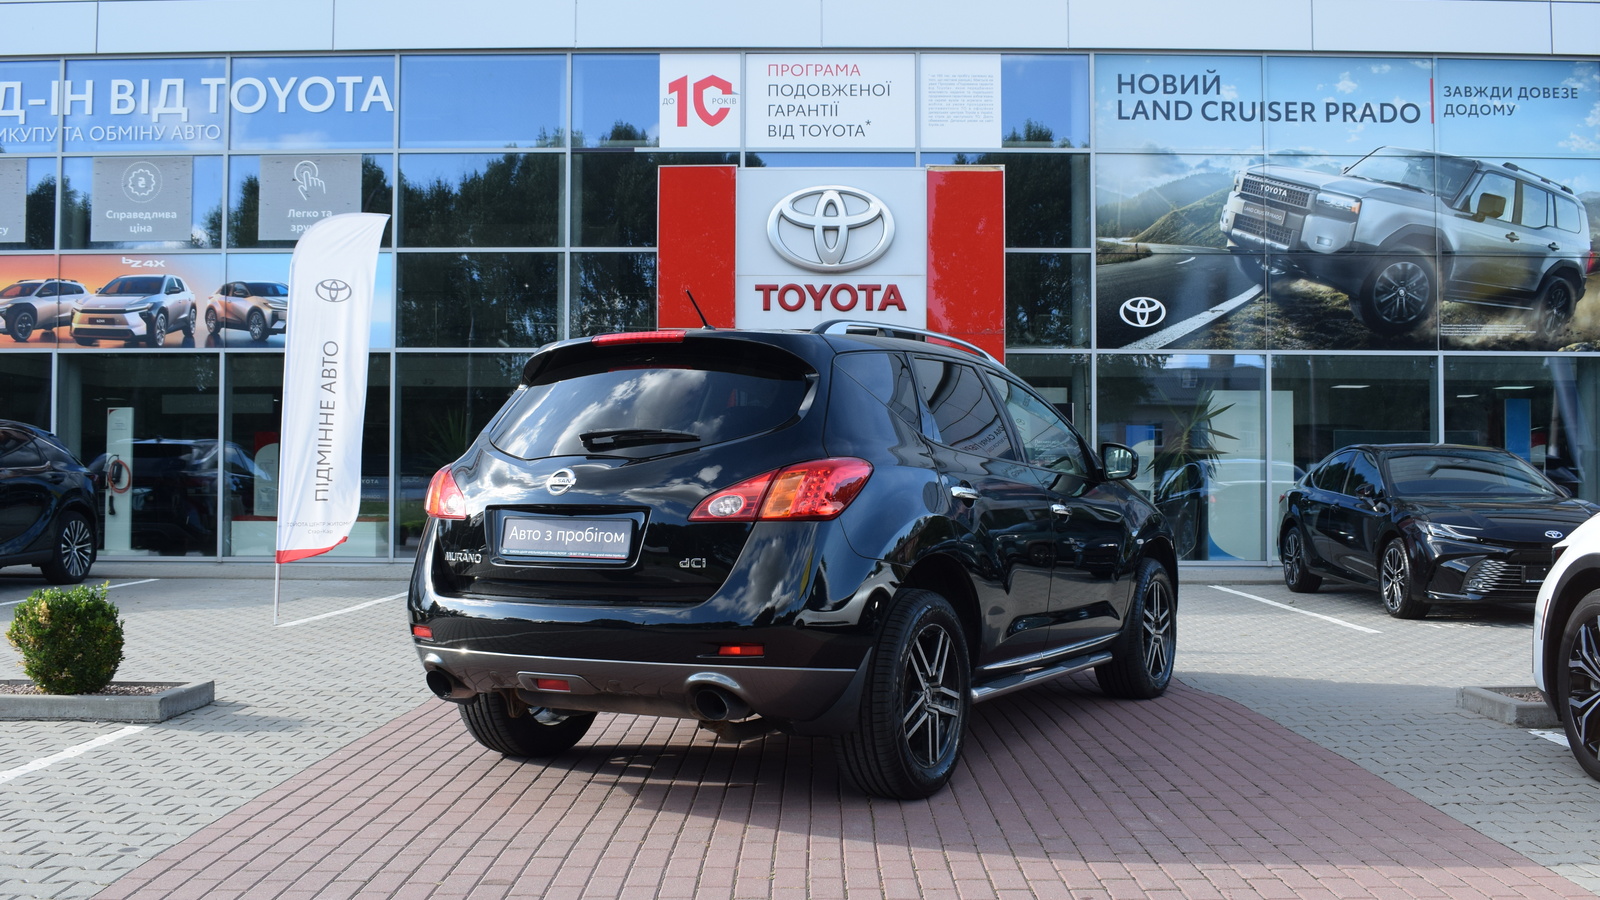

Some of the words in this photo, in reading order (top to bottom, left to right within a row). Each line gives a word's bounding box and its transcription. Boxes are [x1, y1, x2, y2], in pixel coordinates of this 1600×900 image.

[768, 64, 861, 77] ПРОГРАМА
[768, 80, 892, 99] ПОДОВЖЕНОЇ
[1117, 69, 1221, 95] НОВИЙ
[110, 79, 188, 123] ВІД
[201, 76, 394, 114] TOYOTA
[1443, 86, 1513, 100] ЗАВЖДИ
[1517, 87, 1579, 101] ДОВЕЗЕ
[662, 98, 675, 106] ДО
[768, 101, 839, 117] ГАРАНТІЇ
[1117, 100, 1193, 121] LAND
[1201, 101, 1316, 122] CRUISER
[1325, 103, 1421, 124] PRADO
[1443, 104, 1516, 118] ДОДОМУ
[63, 127, 84, 142] ТА
[89, 126, 167, 141] ОБМІНУ
[170, 124, 221, 141] АВТО
[768, 125, 795, 140] ВІД
[1260, 184, 1287, 197] TOYOTA
[105, 210, 178, 221] Справедлива
[287, 209, 319, 218] Легко
[129, 223, 153, 233] ціна
[290, 224, 312, 234] зру
[755, 283, 907, 312] TOYOTA
[320, 340, 339, 394] АВТО
[314, 400, 336, 502] ПІДМІННЕ
[509, 525, 541, 541] Авто
[544, 530, 552, 541] з
[556, 526, 625, 546] пробігом
[444, 551, 482, 564] MURANO
